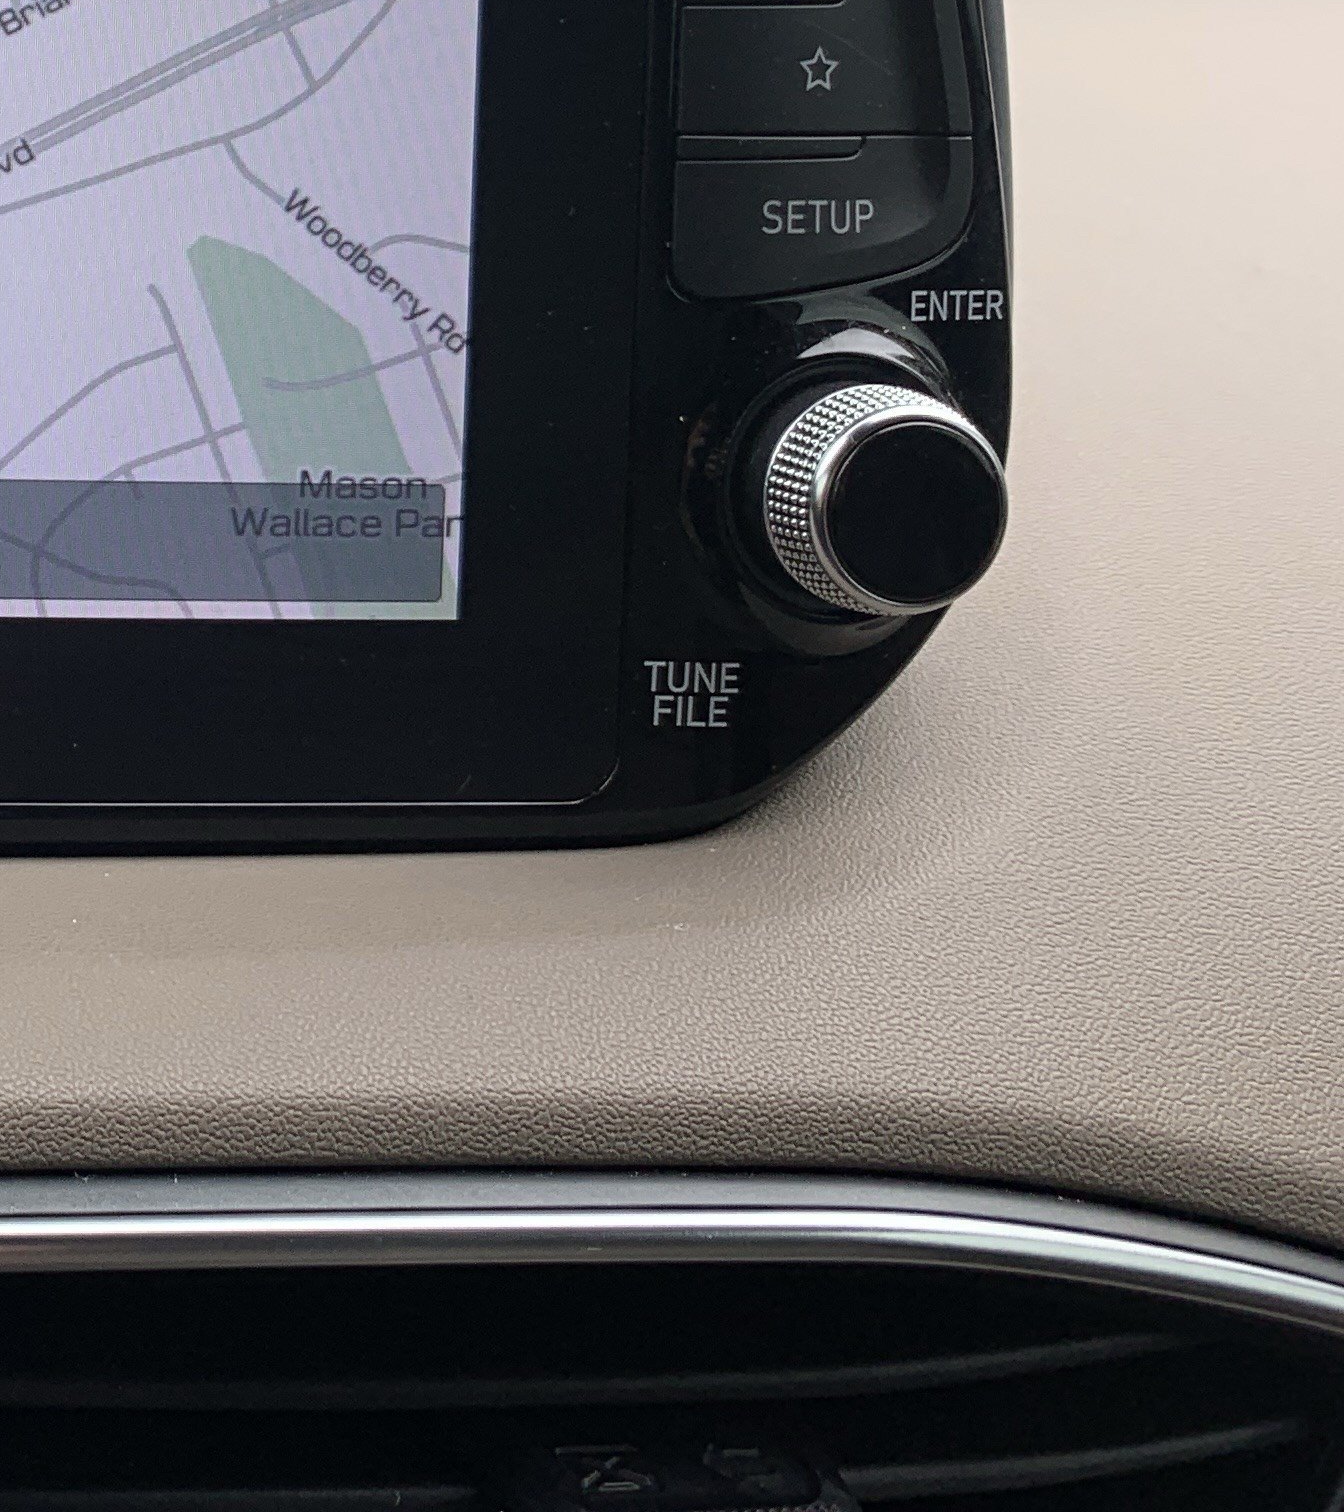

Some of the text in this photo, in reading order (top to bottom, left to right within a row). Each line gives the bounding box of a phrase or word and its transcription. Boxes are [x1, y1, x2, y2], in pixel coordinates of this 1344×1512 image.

[762, 199, 874, 235] SETUP
[283, 188, 470, 355] Woodberry Rd
[911, 290, 1004, 321] ENTER
[299, 469, 428, 500] Mason
[230, 506, 464, 538] Wallace Par
[644, 660, 740, 694] TUNE
[652, 695, 729, 727] FILE
